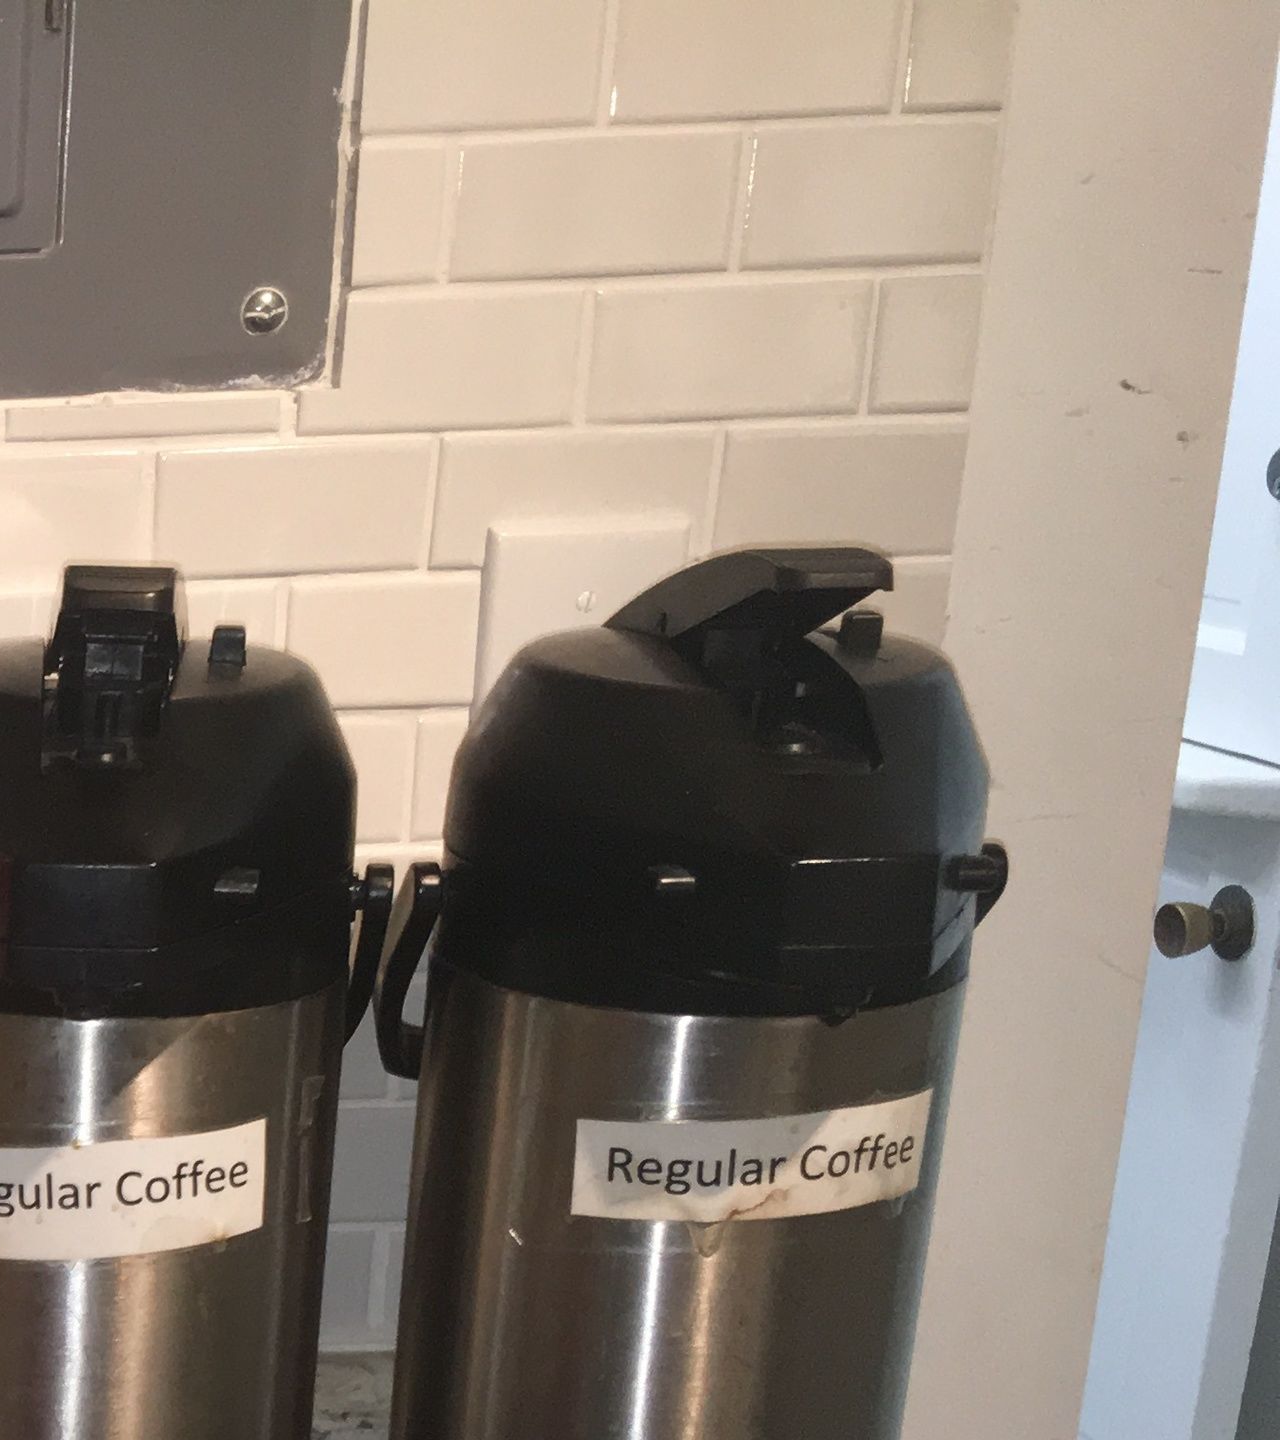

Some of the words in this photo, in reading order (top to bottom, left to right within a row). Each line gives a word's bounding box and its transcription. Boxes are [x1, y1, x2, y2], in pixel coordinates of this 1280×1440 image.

[116, 1159, 249, 1207] Coffee
[607, 1147, 787, 1195] Regular
[800, 1133, 915, 1181] Coffee
